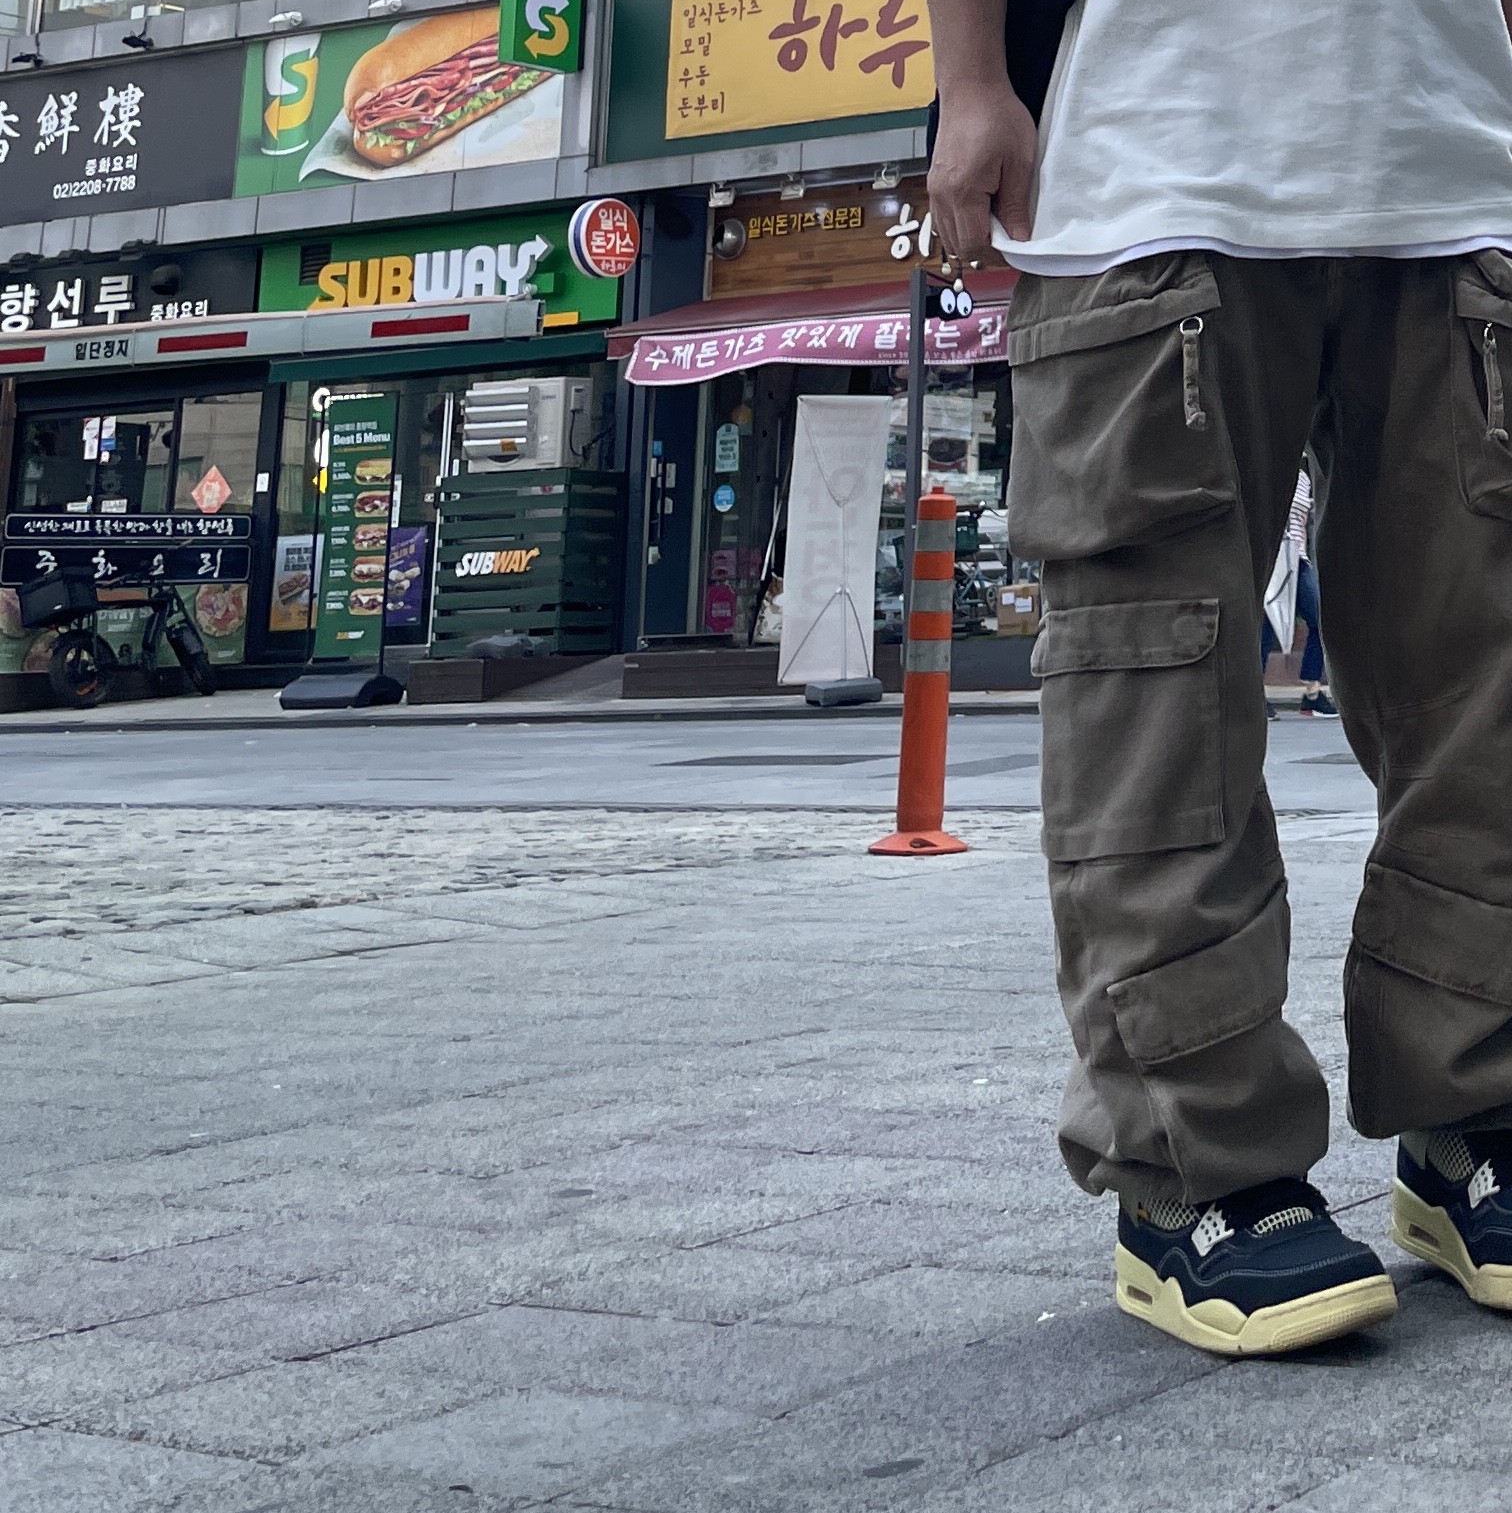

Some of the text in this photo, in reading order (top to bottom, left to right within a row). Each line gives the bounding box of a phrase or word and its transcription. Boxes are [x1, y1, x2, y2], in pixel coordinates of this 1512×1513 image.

[680, 32, 712, 57] 모밀
[679, 65, 711, 89] 우동
[678, 91, 725, 119] 돈부리
[85, 153, 138, 176] 중화요리
[598, 207, 628, 232] 일식
[590, 231, 635, 255] 돈가스
[309, 234, 553, 311] SUBWAY
[0, 275, 135, 334] 향선루
[777, 323, 864, 350] 맛있게
[874, 318, 961, 350] 잘는
[75, 339, 129, 361] 일단정지
[456, 547, 541, 578] SUBWAY
